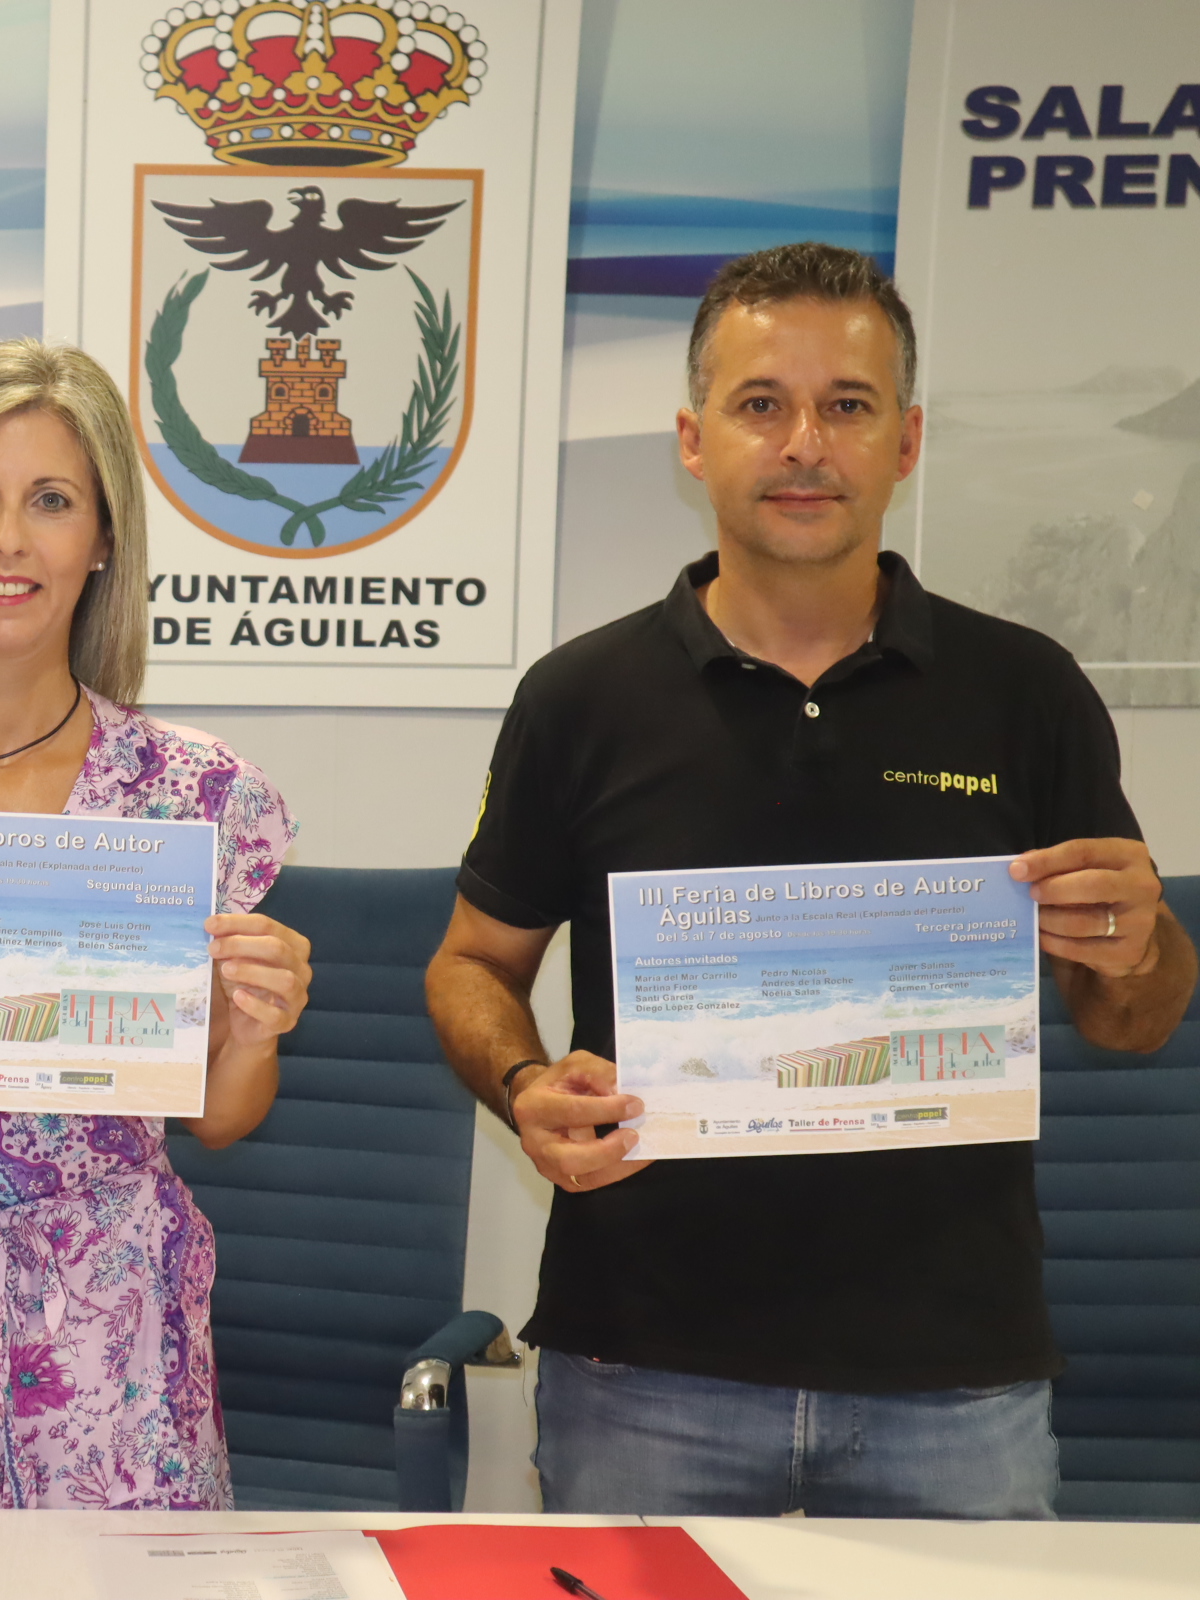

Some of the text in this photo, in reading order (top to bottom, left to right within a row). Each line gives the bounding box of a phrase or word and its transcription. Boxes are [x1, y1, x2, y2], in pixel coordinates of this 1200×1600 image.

[960, 84, 1200, 142] SALA
[147, 574, 487, 607] YUNTAMIENTO
[153, 610, 441, 649] DE ÁGUILAS
[883, 768, 998, 795] centropapel
[55, 831, 85, 850] de
[94, 832, 165, 853] Autor
[39, 861, 90, 871] (Explanada
[110, 865, 143, 875] Puerto)
[87, 879, 195, 894] Segunda jornada
[640, 876, 985, 905] III Feria de Libros de Autor
[136, 893, 194, 906] Sábado 6
[660, 904, 752, 930] Águilas
[860, 909, 911, 919] (Explanada
[931, 906, 965, 914] Puerto)
[105, 922, 124, 930] Luis
[915, 919, 1017, 932] Tercera jornada
[21, 928, 62, 937] Campillo
[79, 931, 140, 941] Sergio Reyes
[657, 930, 782, 942] Del 5 al 7 de agosto
[950, 930, 1017, 942] Domingo 7
[25, 939, 63, 947] Merinos
[78, 941, 148, 951] Belén Sánchez
[635, 954, 738, 966] Autores invitados
[889, 962, 955, 972] Javier Salinas
[702, 972, 738, 980] Carrillo
[792, 968, 827, 977] Nicolás
[889, 973, 943, 982] Guillermina
[824, 977, 854, 985] Roche
[636, 984, 670, 992] Martina
[889, 982, 969, 992] Carmen Torrente
[636, 994, 660, 1002] Santi
[762, 989, 792, 997] Noelia
[636, 1005, 662, 1013] Diego
[697, 1002, 740, 1010] González
[788, 1119, 815, 1127] Taller
[818, 1118, 829, 1126] de
[833, 1118, 865, 1126] Prensa
